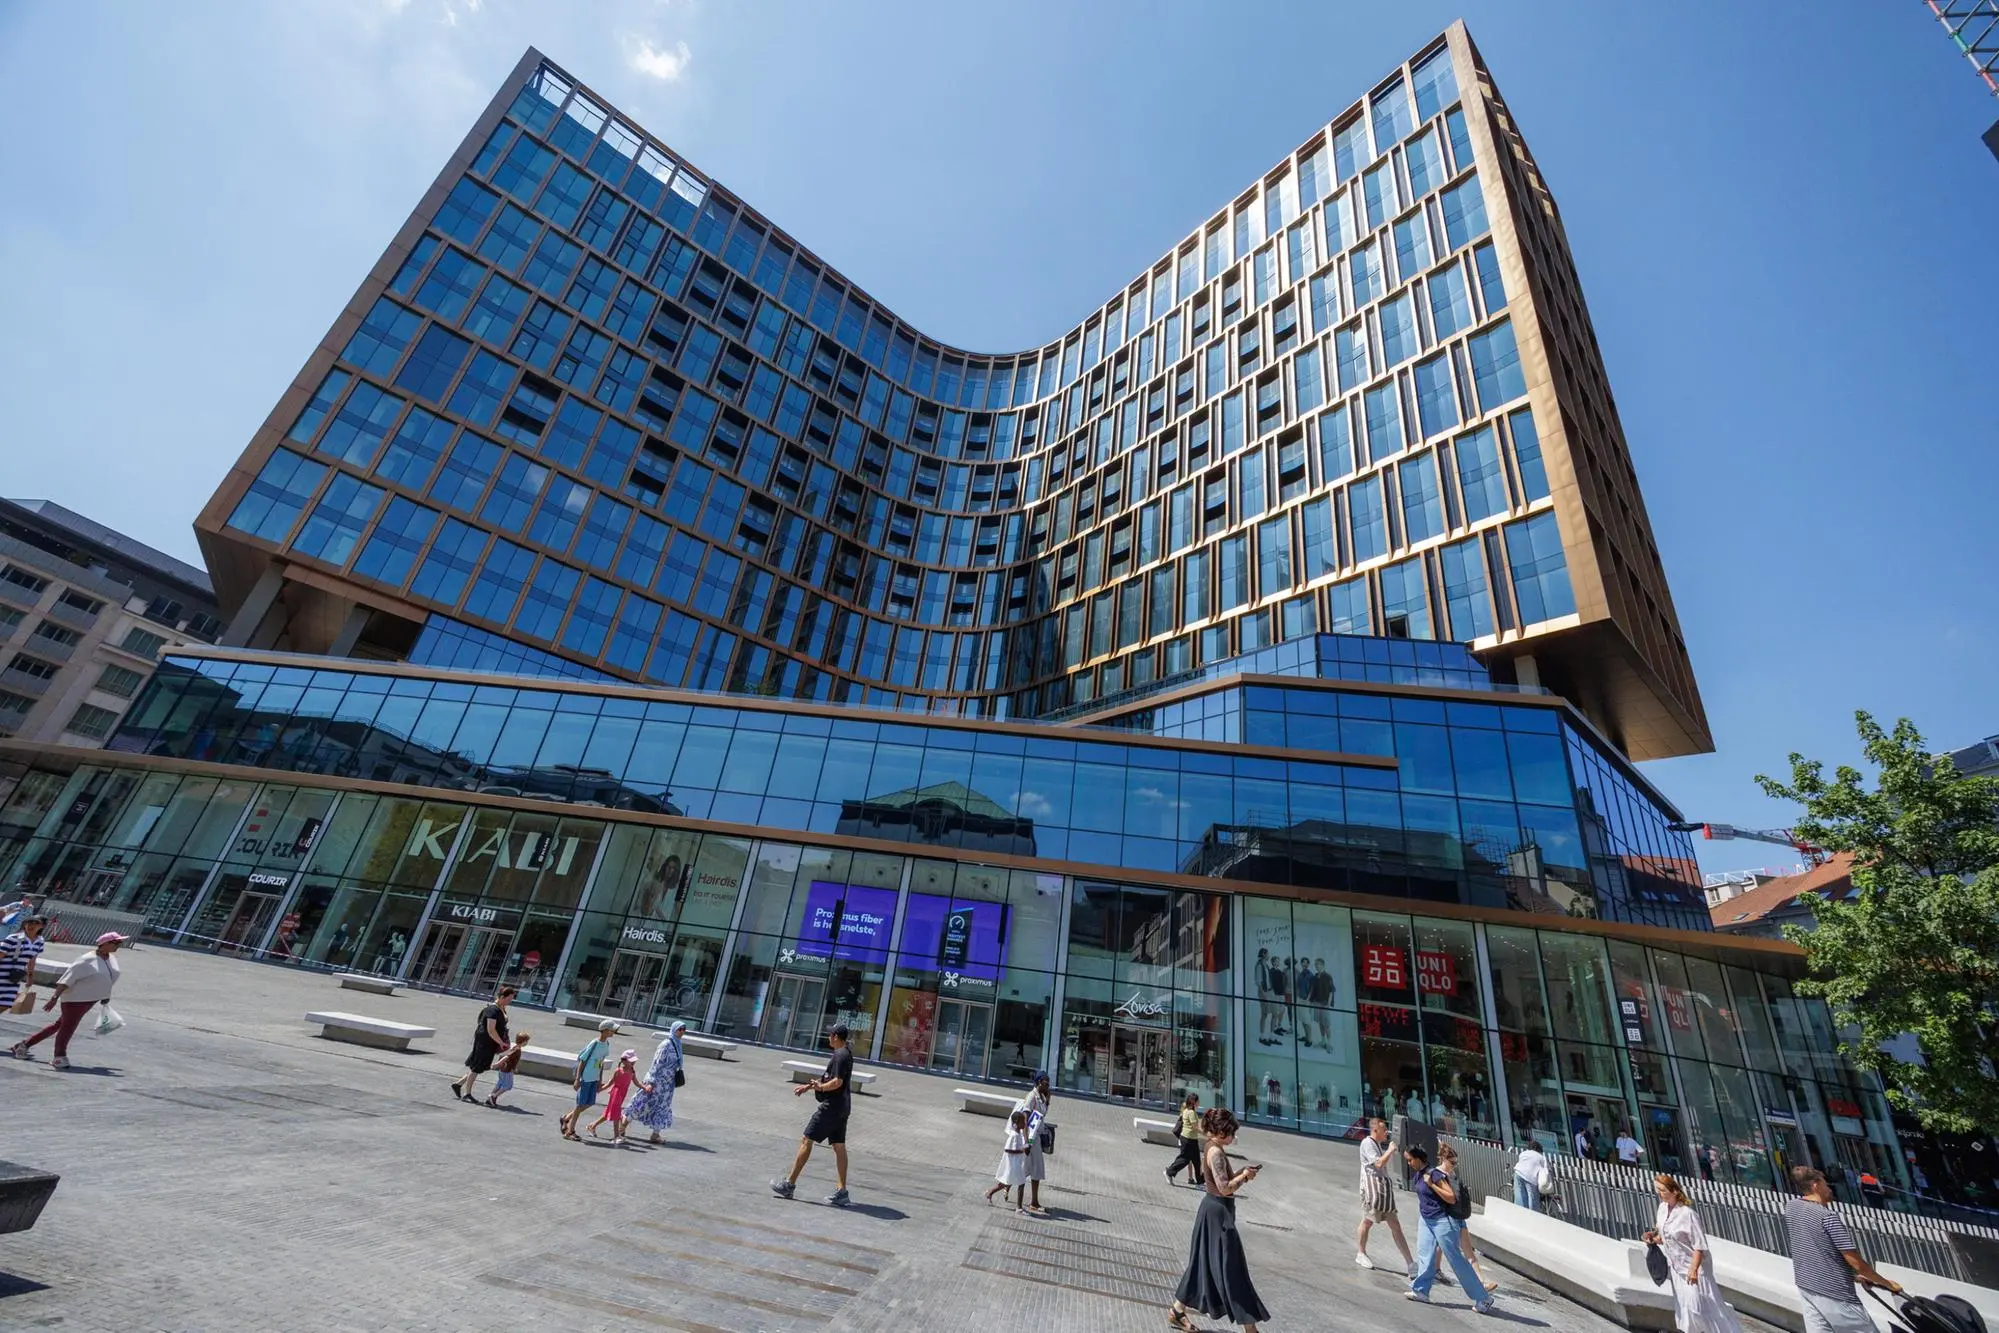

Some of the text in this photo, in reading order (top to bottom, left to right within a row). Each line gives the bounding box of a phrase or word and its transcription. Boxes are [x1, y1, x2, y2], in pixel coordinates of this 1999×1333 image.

[248, 873, 288, 887] COURIR
[451, 904, 498, 922] KIABI
[860, 913, 884, 925] fiber
[622, 925, 667, 944] Hairdis.
[813, 917, 877, 937] is he snelste,
[795, 952, 827, 964] proximus
[1416, 955, 1447, 973] UNI
[960, 976, 993, 987] proximus
[1419, 972, 1452, 991] QLO
[1114, 991, 1169, 1020] Lovisa
